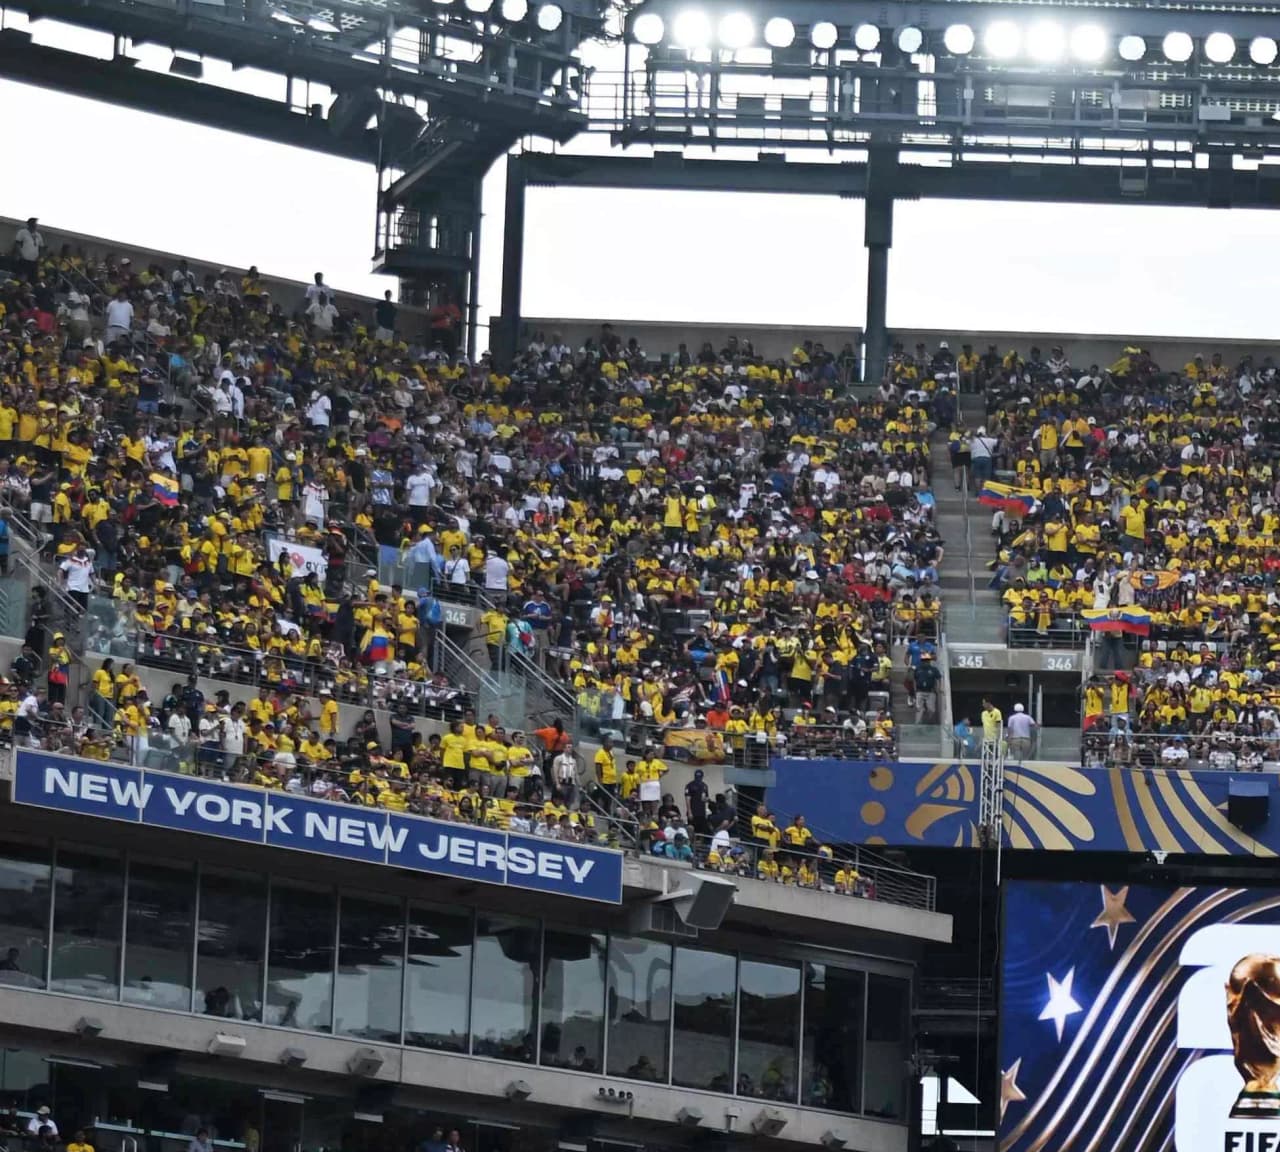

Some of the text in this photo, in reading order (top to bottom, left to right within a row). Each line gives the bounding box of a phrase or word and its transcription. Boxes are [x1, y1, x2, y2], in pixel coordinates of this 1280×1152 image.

[445, 610, 467, 626] 345
[957, 655, 982, 667] 345
[1046, 657, 1070, 669] 346
[44, 767, 595, 884] NEW YORK NEW JERSEY
